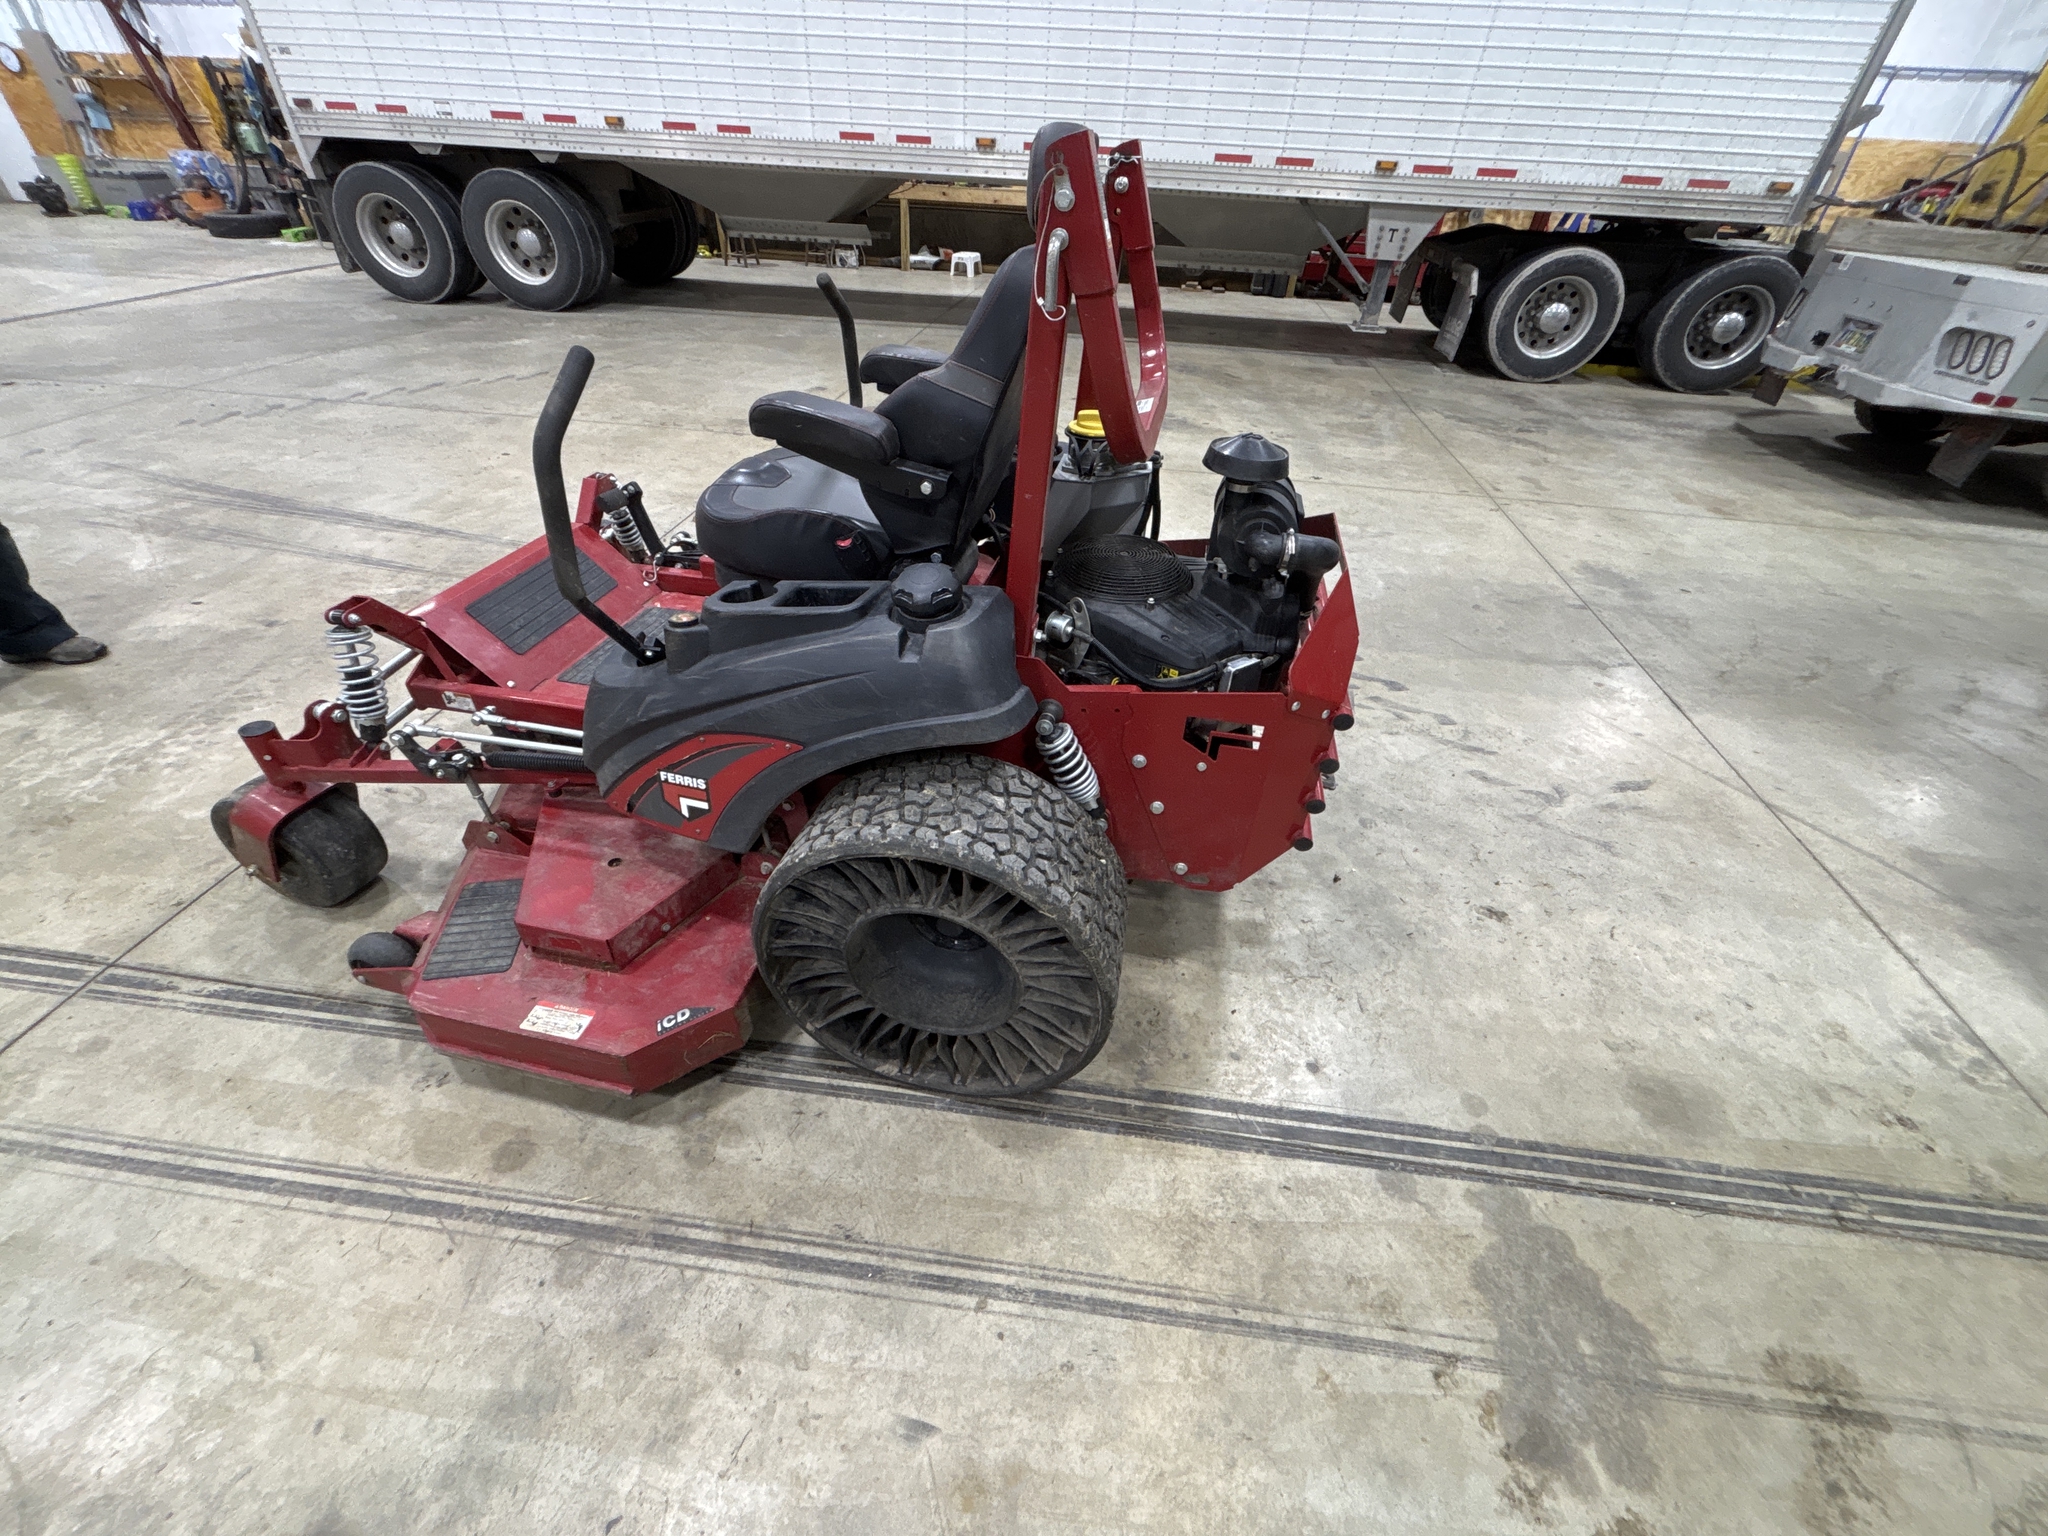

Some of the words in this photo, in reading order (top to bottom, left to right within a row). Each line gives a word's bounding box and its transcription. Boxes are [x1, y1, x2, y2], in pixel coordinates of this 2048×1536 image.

[1388, 227, 1399, 243] T
[659, 770, 707, 790] FERRIS
[656, 1008, 691, 1032] iCD
